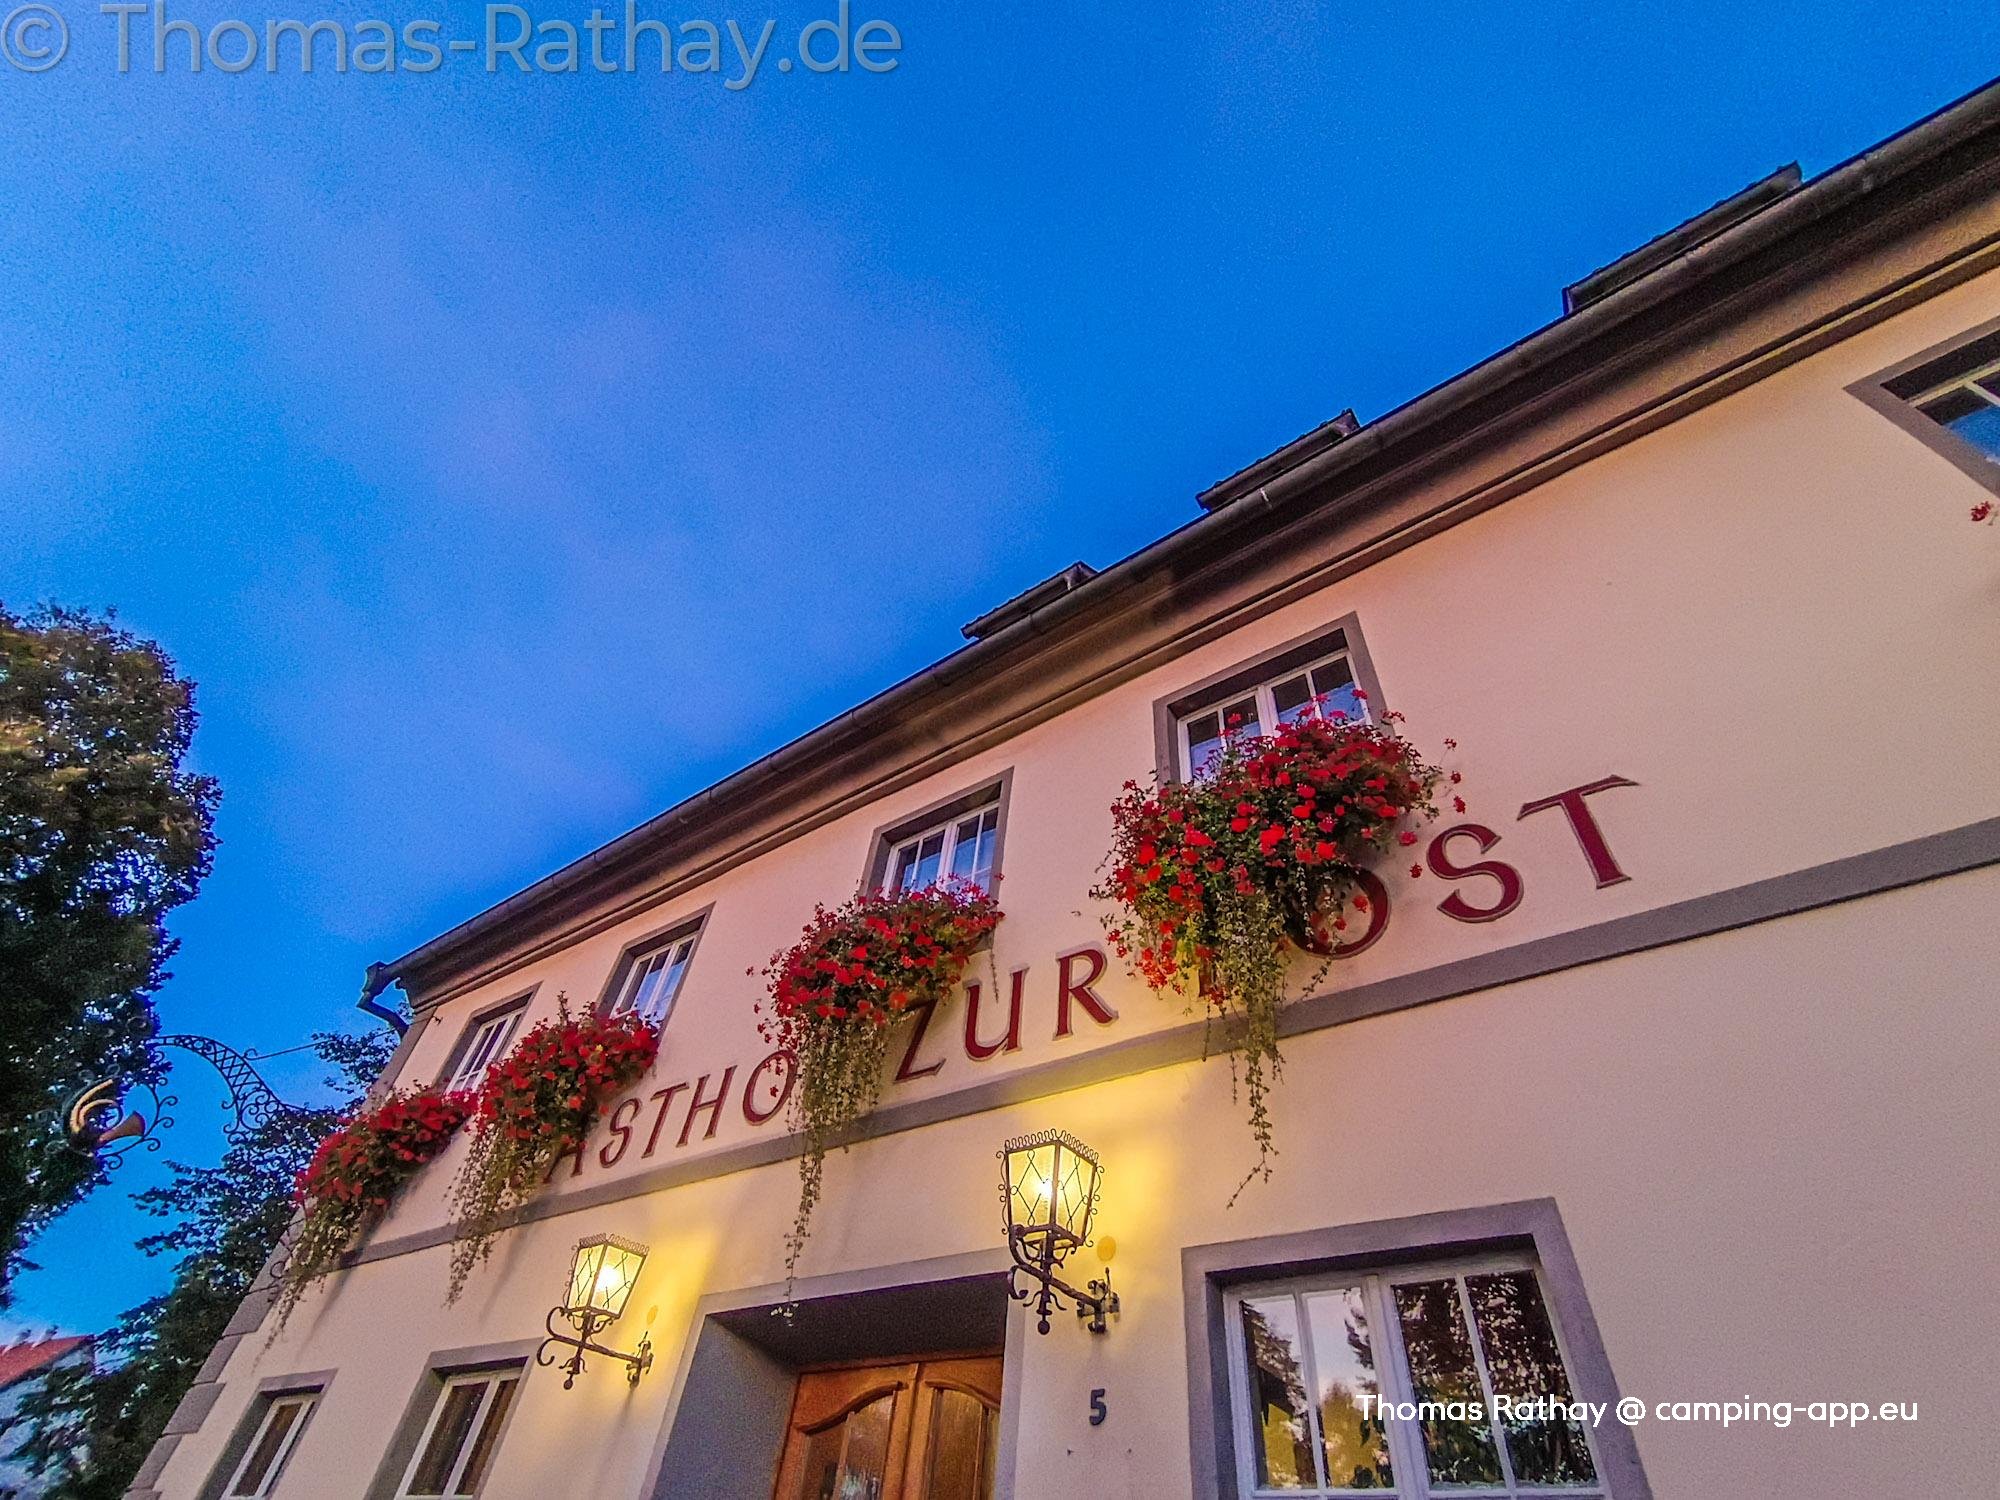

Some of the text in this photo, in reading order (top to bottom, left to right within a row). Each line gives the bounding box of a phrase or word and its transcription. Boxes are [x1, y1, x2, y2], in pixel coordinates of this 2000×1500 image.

[541, 774, 1641, 1185] ASTHO ZUR OST
[1089, 1388, 1107, 1426] 5
